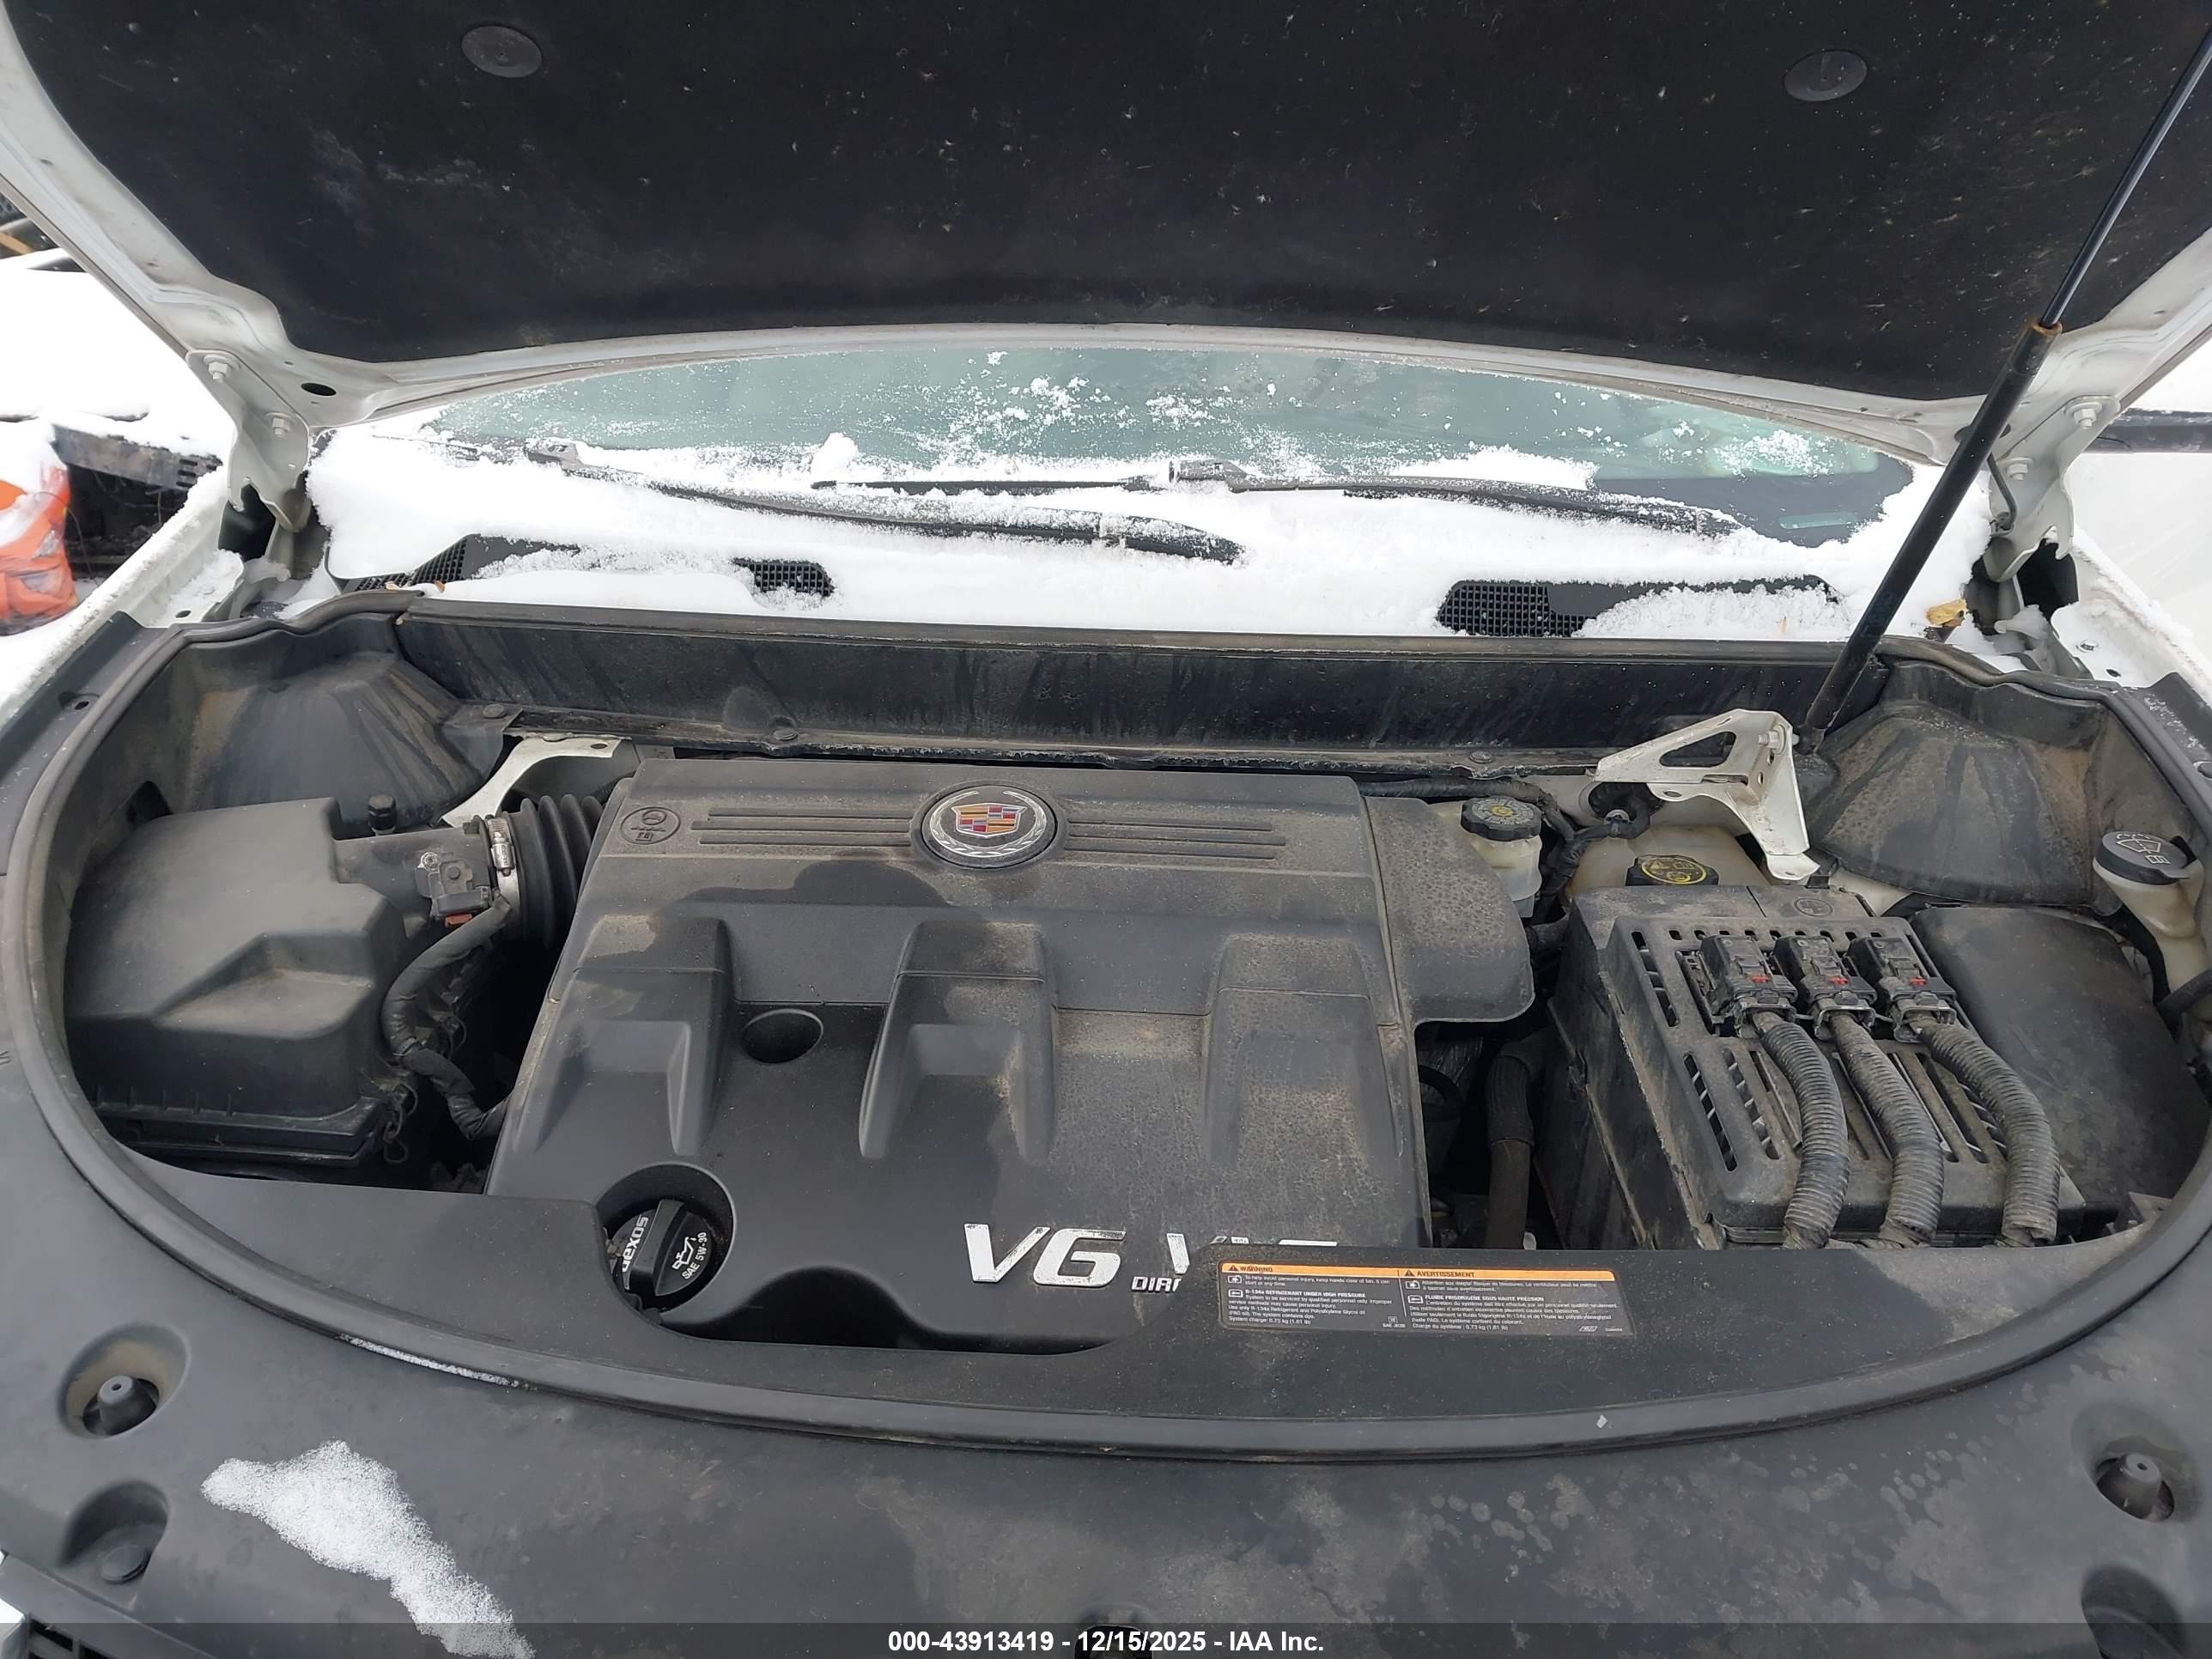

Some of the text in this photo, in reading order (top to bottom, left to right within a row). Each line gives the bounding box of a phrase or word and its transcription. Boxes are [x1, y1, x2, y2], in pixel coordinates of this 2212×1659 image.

[681, 1231, 708, 1279] SAE 5W-30
[963, 1223, 1127, 1287] V6
